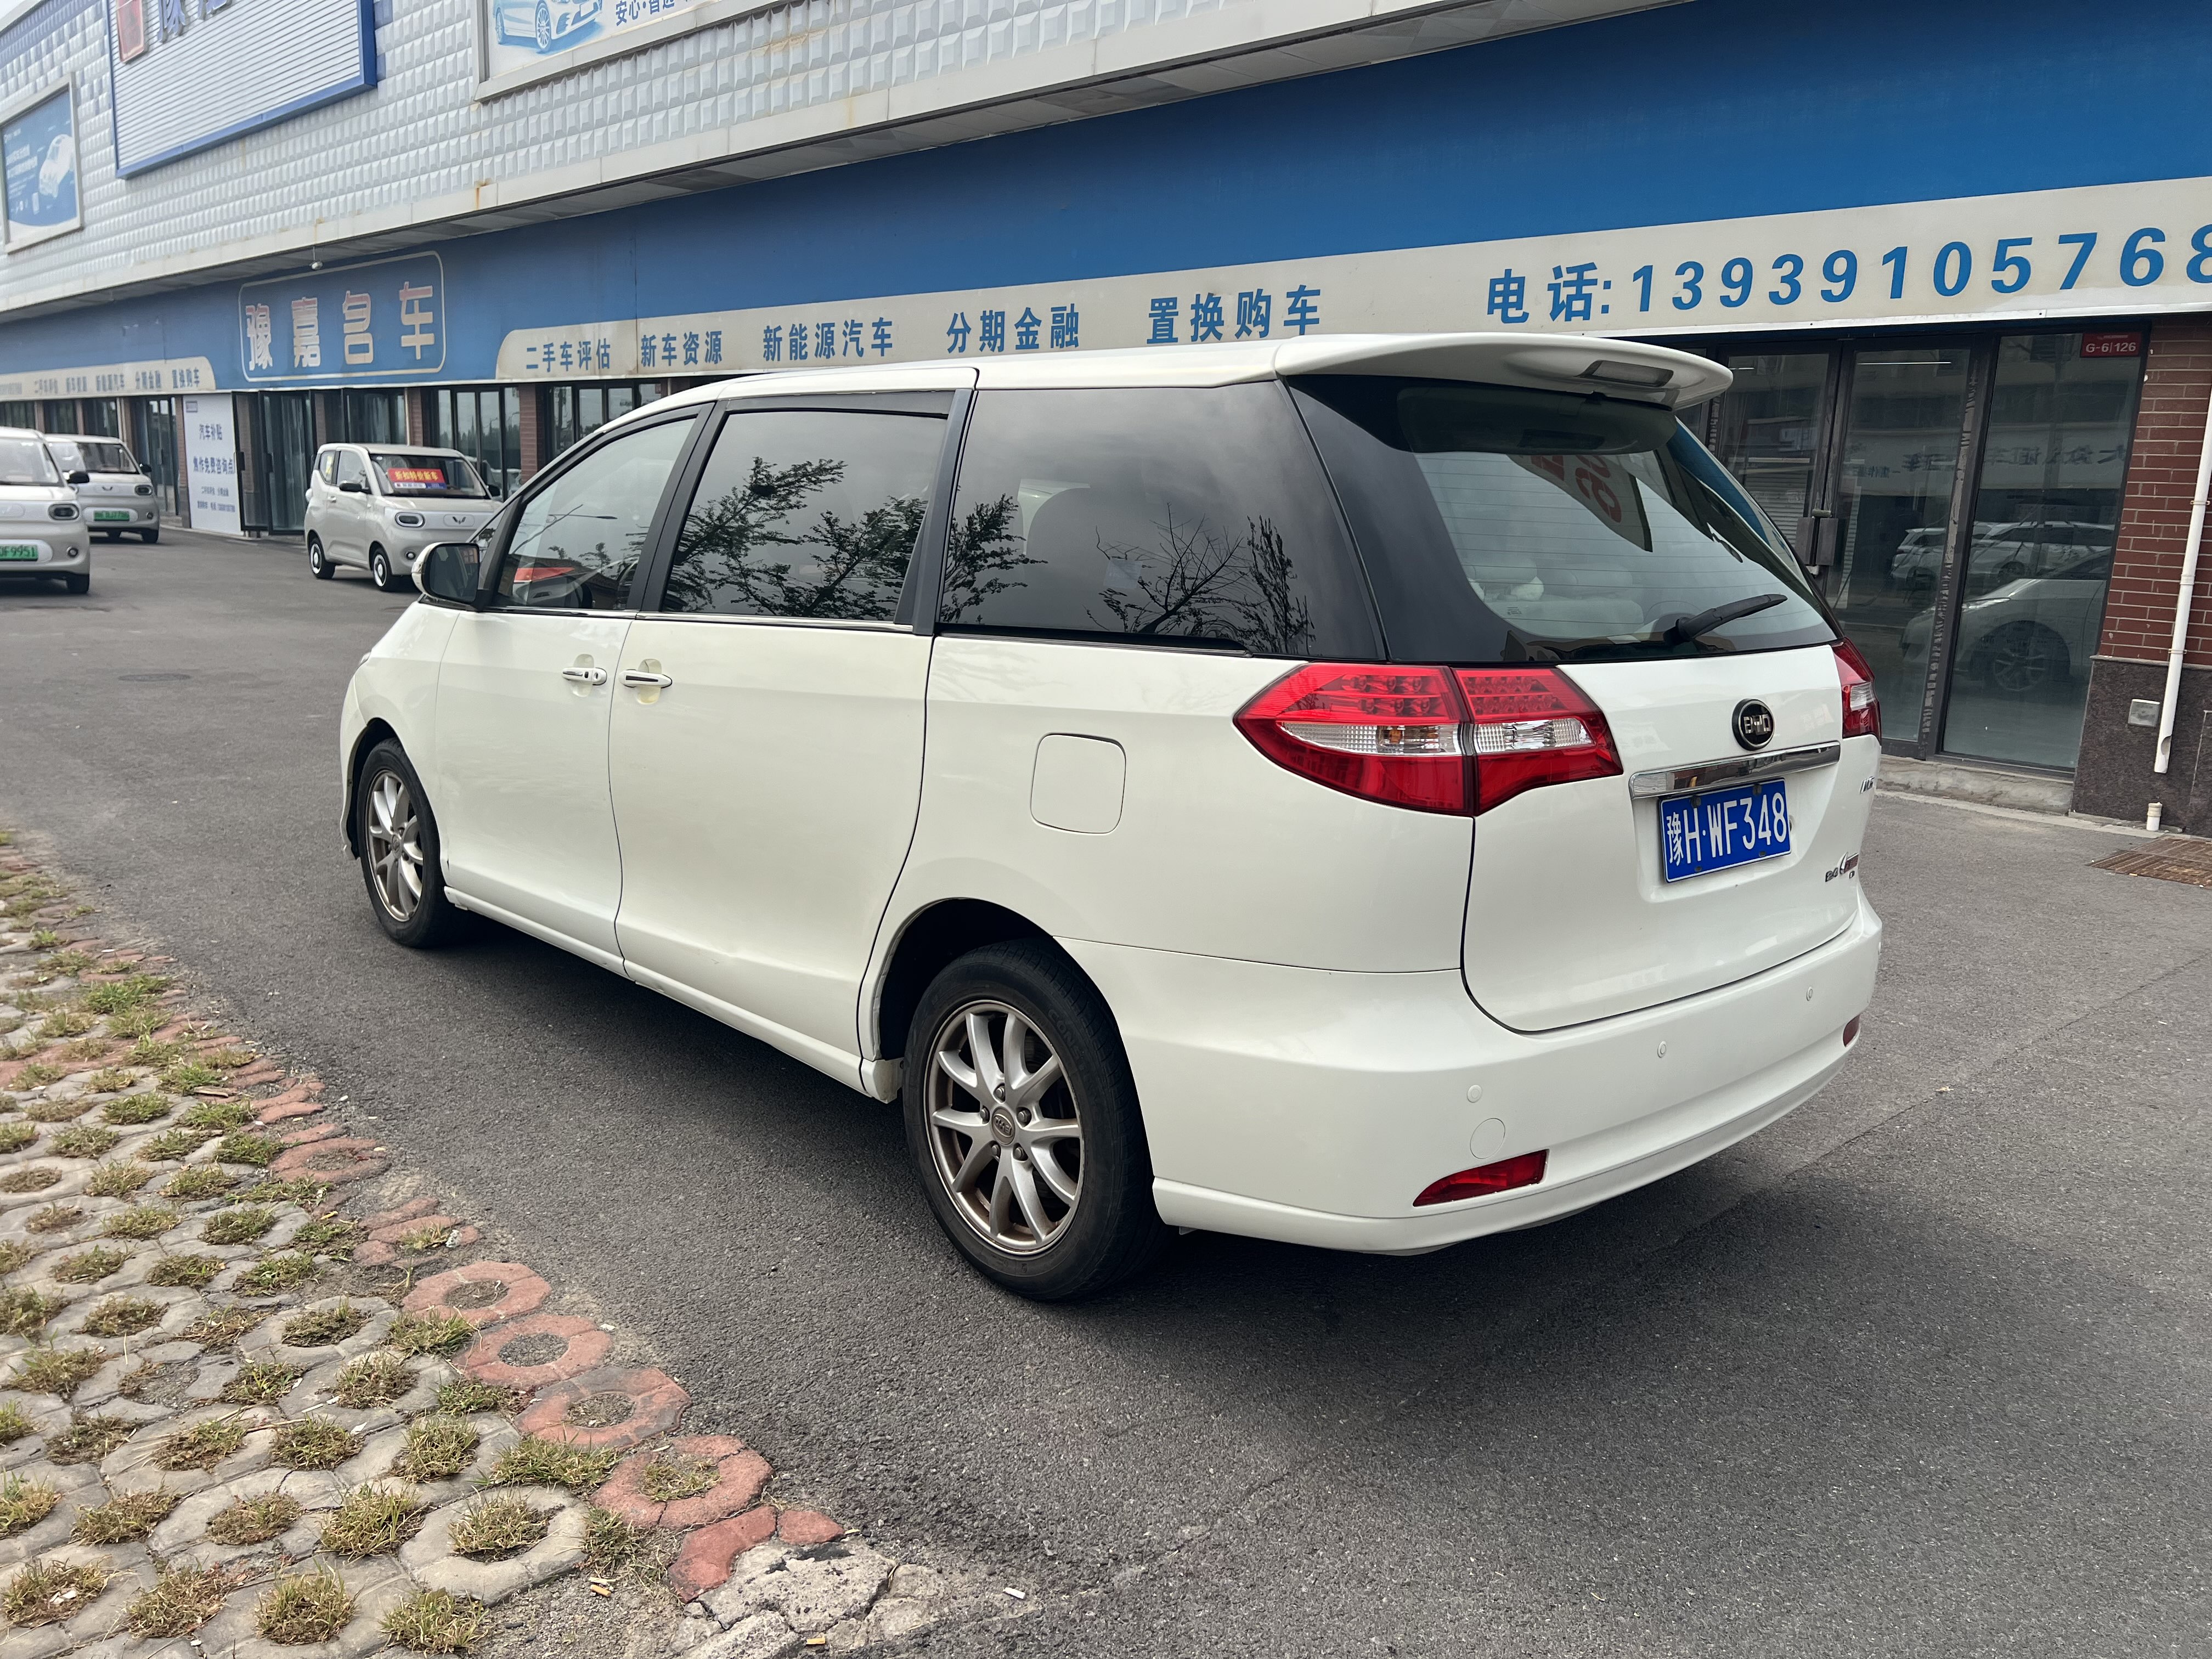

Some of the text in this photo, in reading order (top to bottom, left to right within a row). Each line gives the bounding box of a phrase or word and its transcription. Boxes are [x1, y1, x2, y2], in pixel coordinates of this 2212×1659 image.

[245, 281, 435, 371] 豫嘉名车
[527, 284, 1321, 373] 二手车评估 新车资源 新能源汽车 分期金融 置换购车
[1743, 714, 1771, 736] BYD
